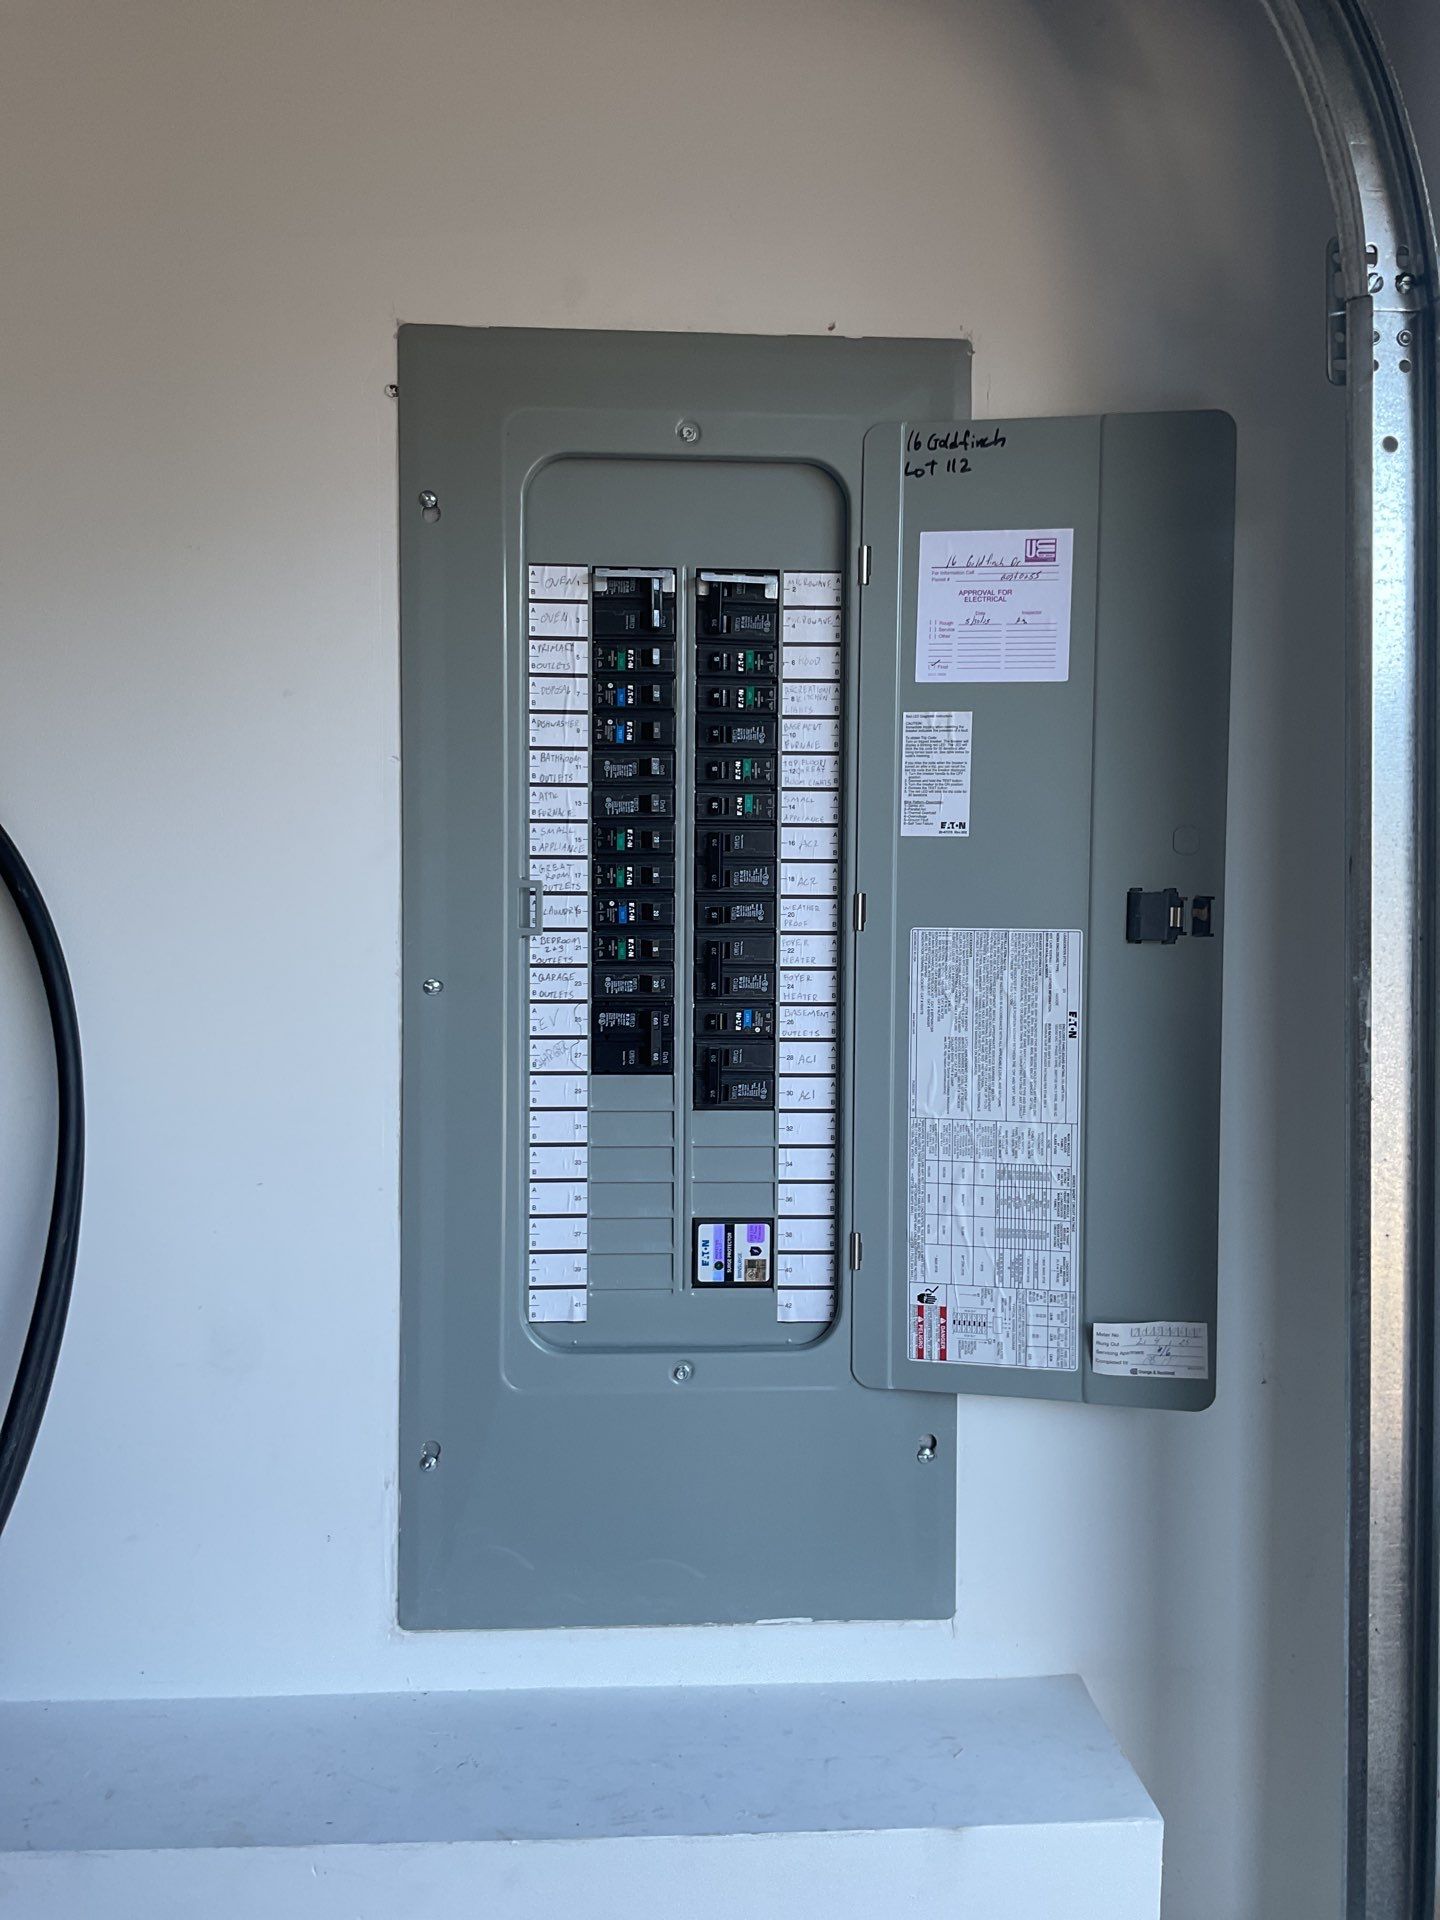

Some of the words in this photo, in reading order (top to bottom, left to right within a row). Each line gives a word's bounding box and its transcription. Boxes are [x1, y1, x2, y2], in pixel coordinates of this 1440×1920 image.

[907, 430, 922, 452] 16
[927, 428, 1006, 451] Goldfinch
[947, 458, 972, 473] 112
[946, 555, 957, 568] 16
[545, 575, 576, 589] OVEN
[540, 611, 568, 624] OVEN
[541, 827, 575, 835] SMALL
[539, 863, 574, 873] GREAT
[543, 905, 579, 917] LAUNDRY
[540, 936, 581, 945] BEDROOM
[539, 991, 574, 999] OUTLETS
[784, 1009, 829, 1018] BASEMENT
